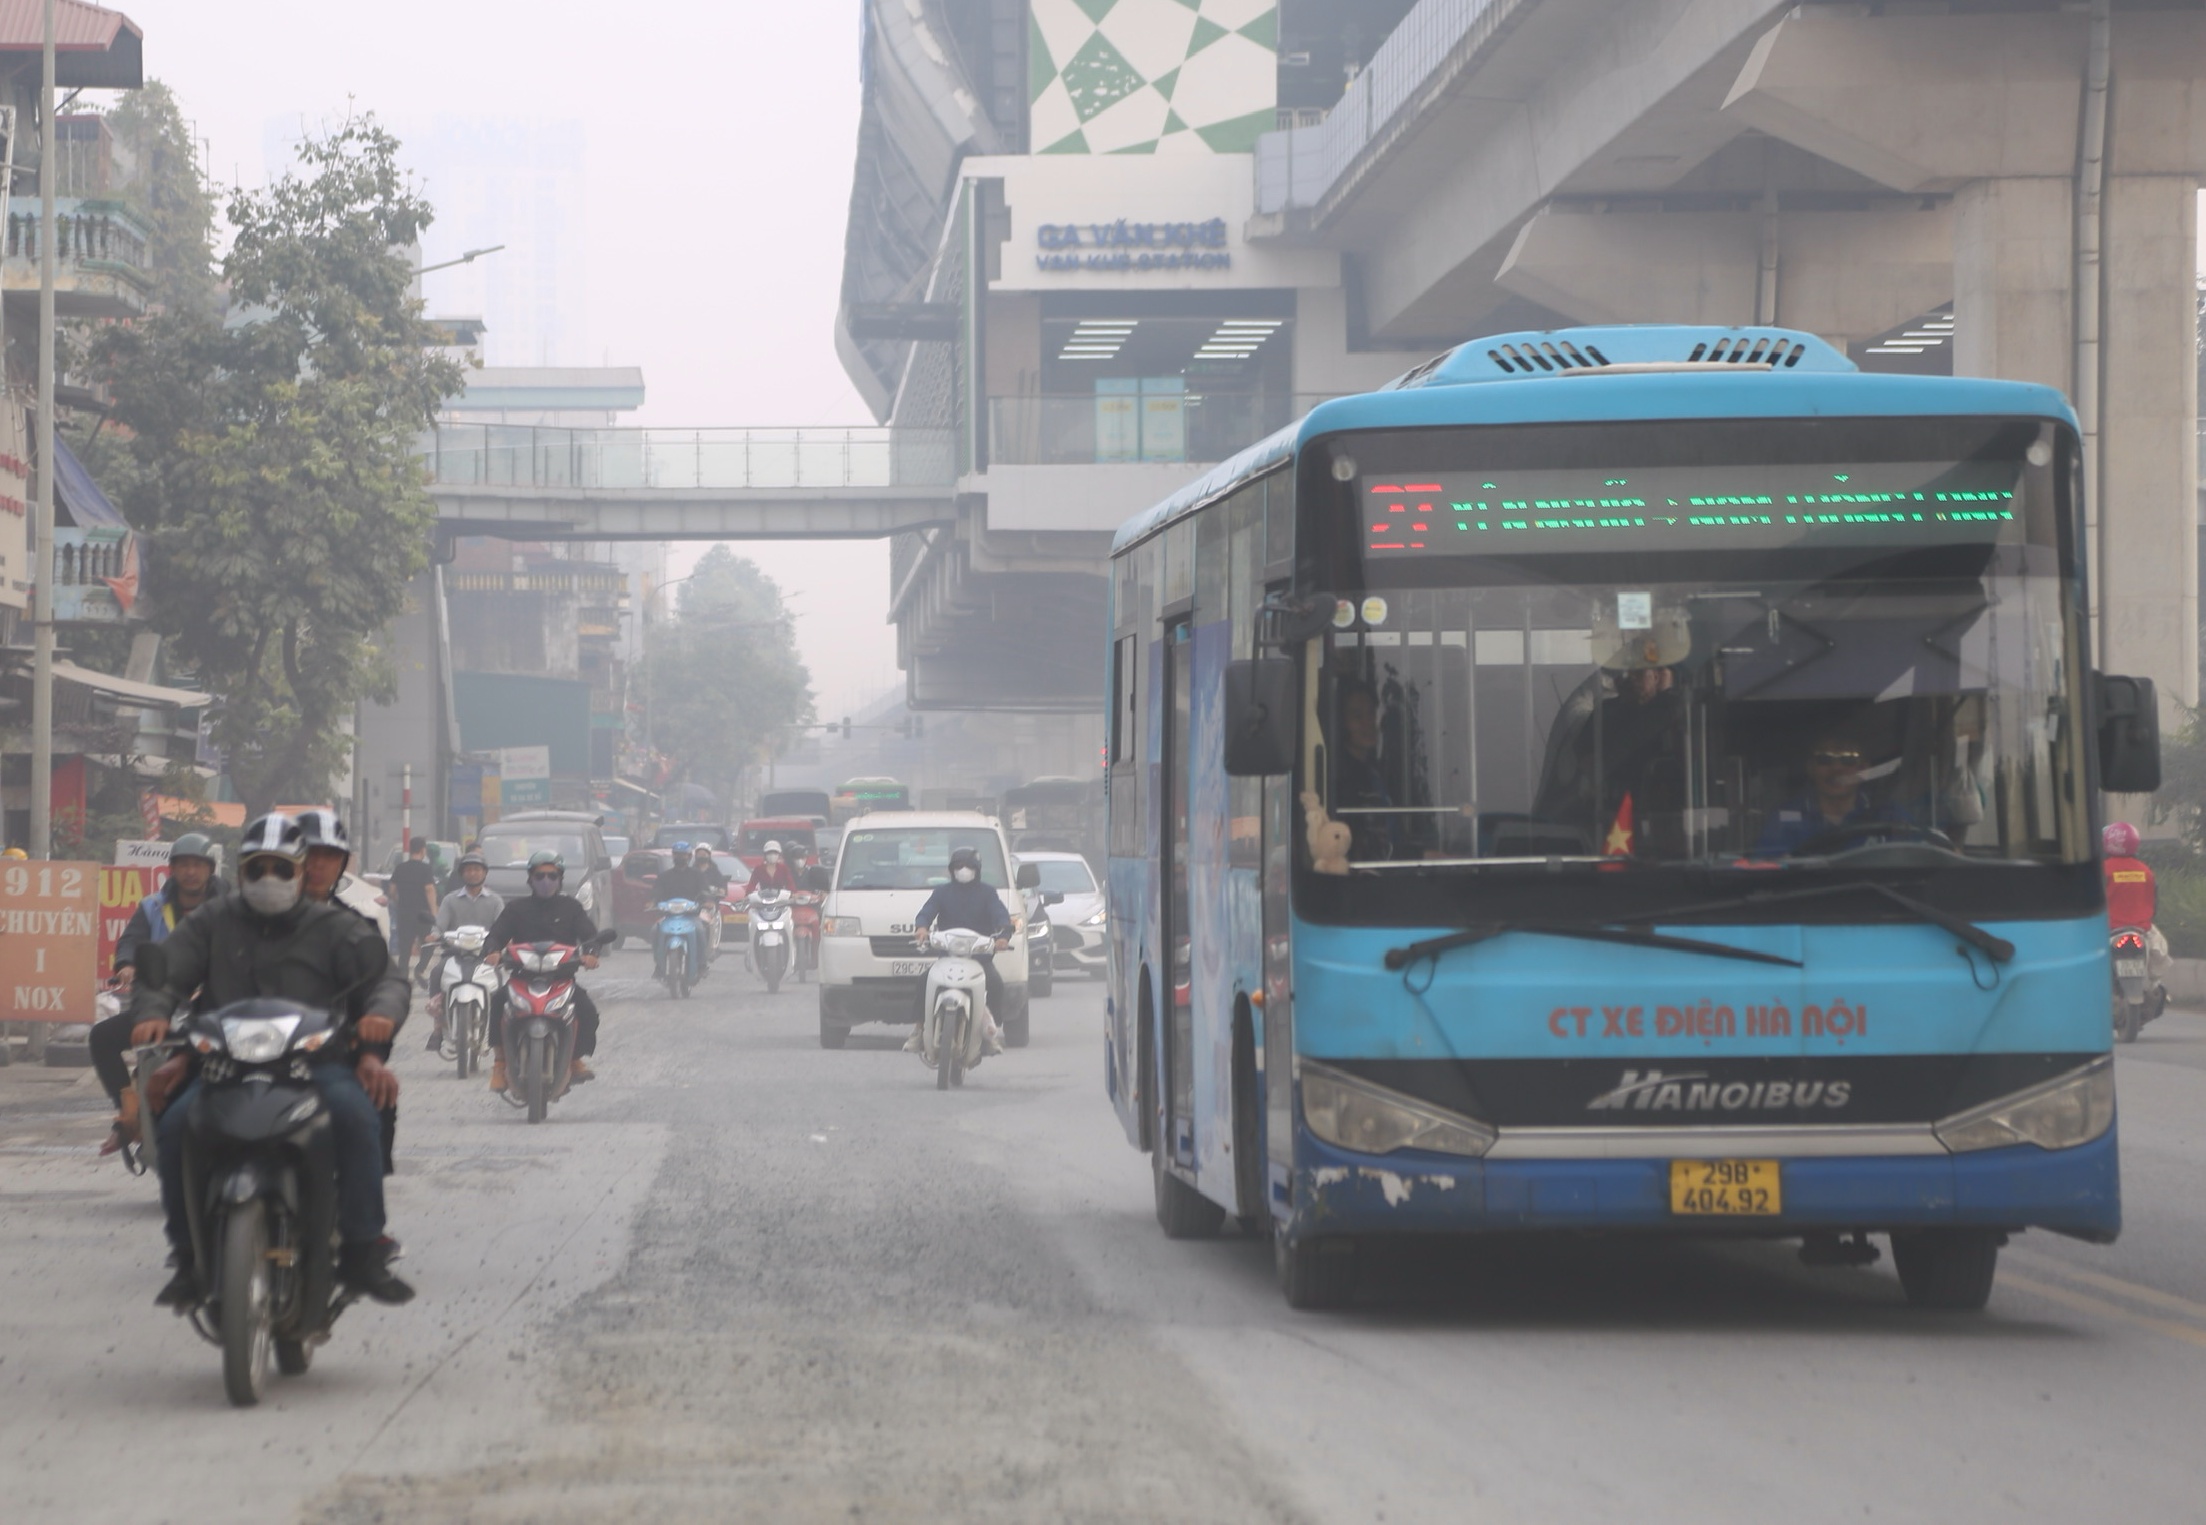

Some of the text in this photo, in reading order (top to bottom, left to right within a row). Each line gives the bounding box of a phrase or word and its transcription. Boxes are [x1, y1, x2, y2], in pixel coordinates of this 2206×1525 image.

[1037, 223, 1081, 249] GA
[1137, 251, 1231, 270] STATION
[5, 866, 82, 898] 912
[13, 986, 66, 1011] NOX
[1548, 997, 1867, 1047] CT XE ĐIỆN HÀ NỘI
[1703, 1162, 1749, 1185] 29B
[1683, 1187, 1770, 1213] 404.92
